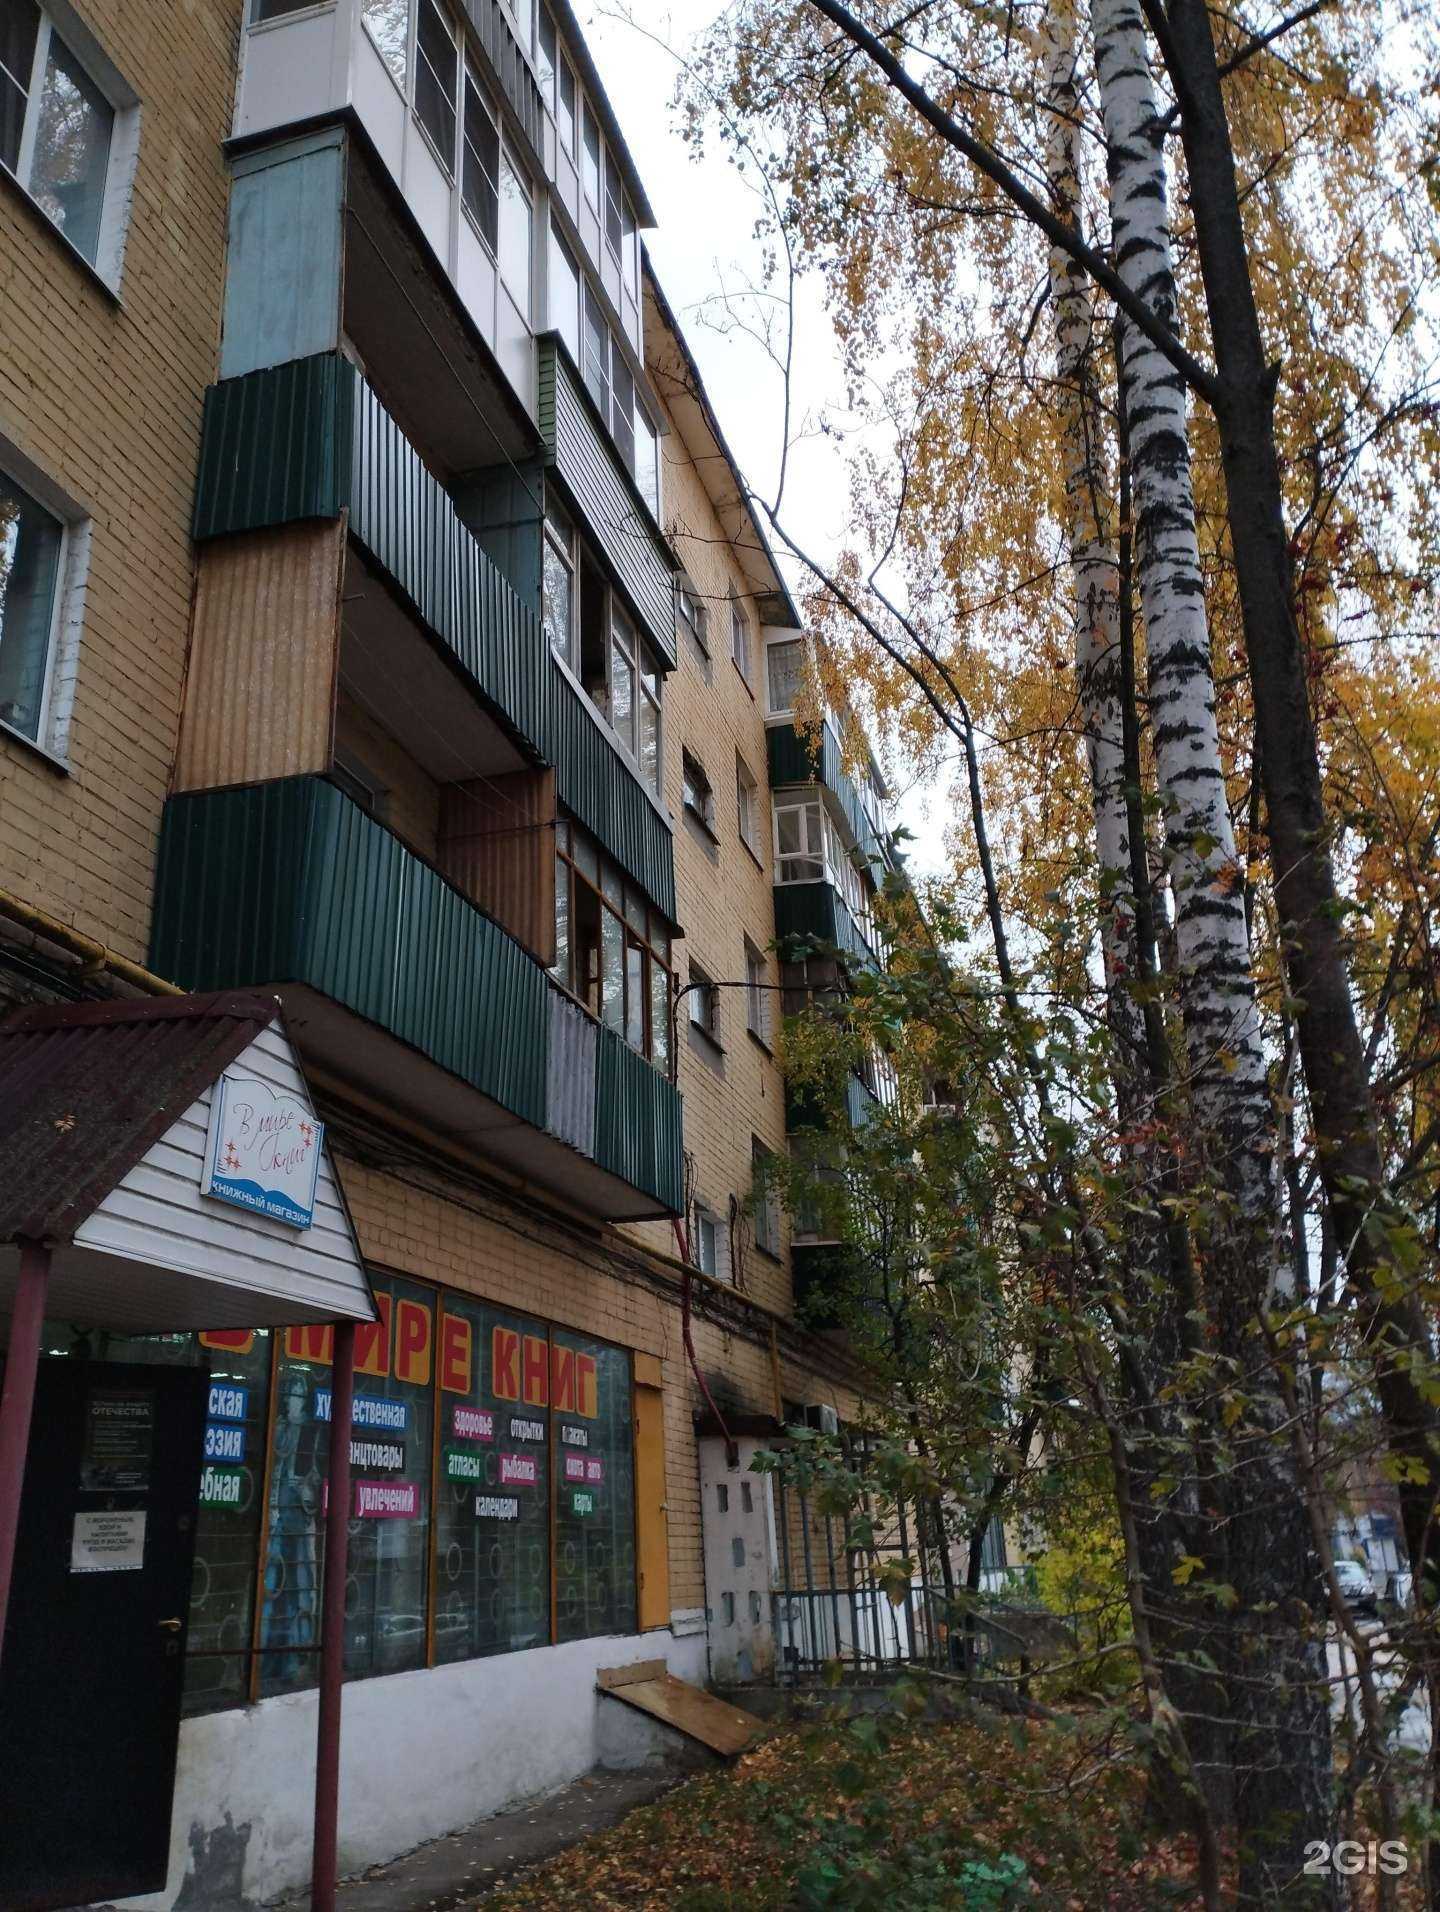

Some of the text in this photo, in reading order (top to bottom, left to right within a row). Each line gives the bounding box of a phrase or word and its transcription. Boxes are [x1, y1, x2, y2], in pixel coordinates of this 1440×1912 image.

[493, 1328, 596, 1417] КНИГ
[208, 1387, 243, 1418] ская
[316, 1392, 406, 1428] хуественная
[455, 1410, 493, 1437] здоровье
[511, 1417, 544, 1442] открытки
[206, 1428, 242, 1457] эзия
[449, 1453, 480, 1478] атласы
[502, 1455, 535, 1483] рыбалка
[359, 1486, 414, 1517] увлечений
